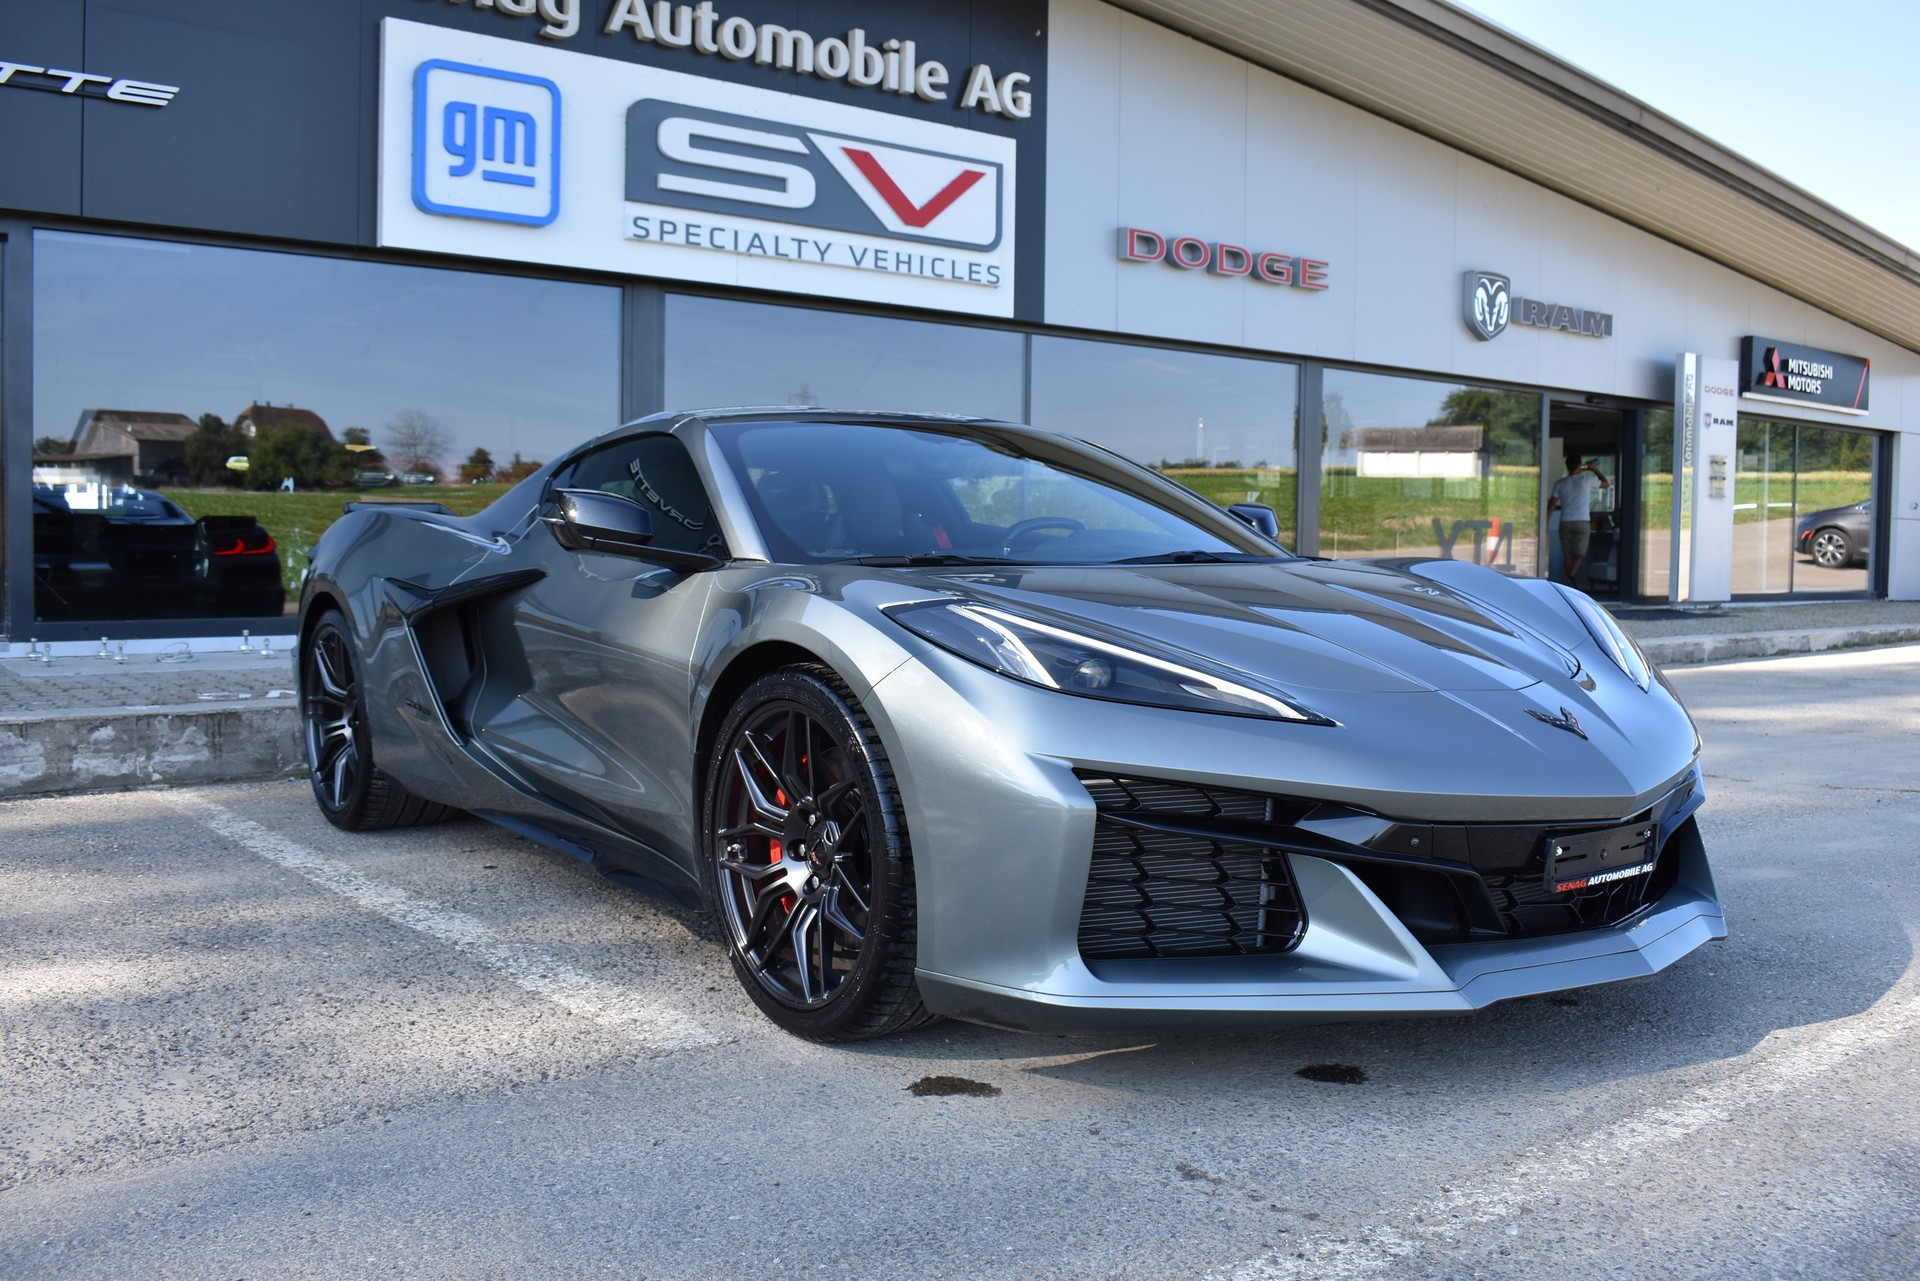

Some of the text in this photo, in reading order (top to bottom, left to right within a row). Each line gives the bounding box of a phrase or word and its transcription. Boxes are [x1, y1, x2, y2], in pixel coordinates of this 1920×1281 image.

[603, 0, 949, 101] Automobile
[960, 64, 1031, 120] AG
[443, 101, 536, 178] gm
[632, 216, 1000, 285] SPECIALTY VEHICLES
[1119, 227, 1329, 290] DODGE
[1514, 297, 1613, 337] RAM
[1788, 358, 1833, 380] MITSUBISHI
[1788, 375, 1822, 395] MOTORS
[1704, 385, 1735, 397] DODGE
[1713, 417, 1734, 427] RAM
[1557, 863, 1653, 892] SENAG AUTOMOBILE AG
